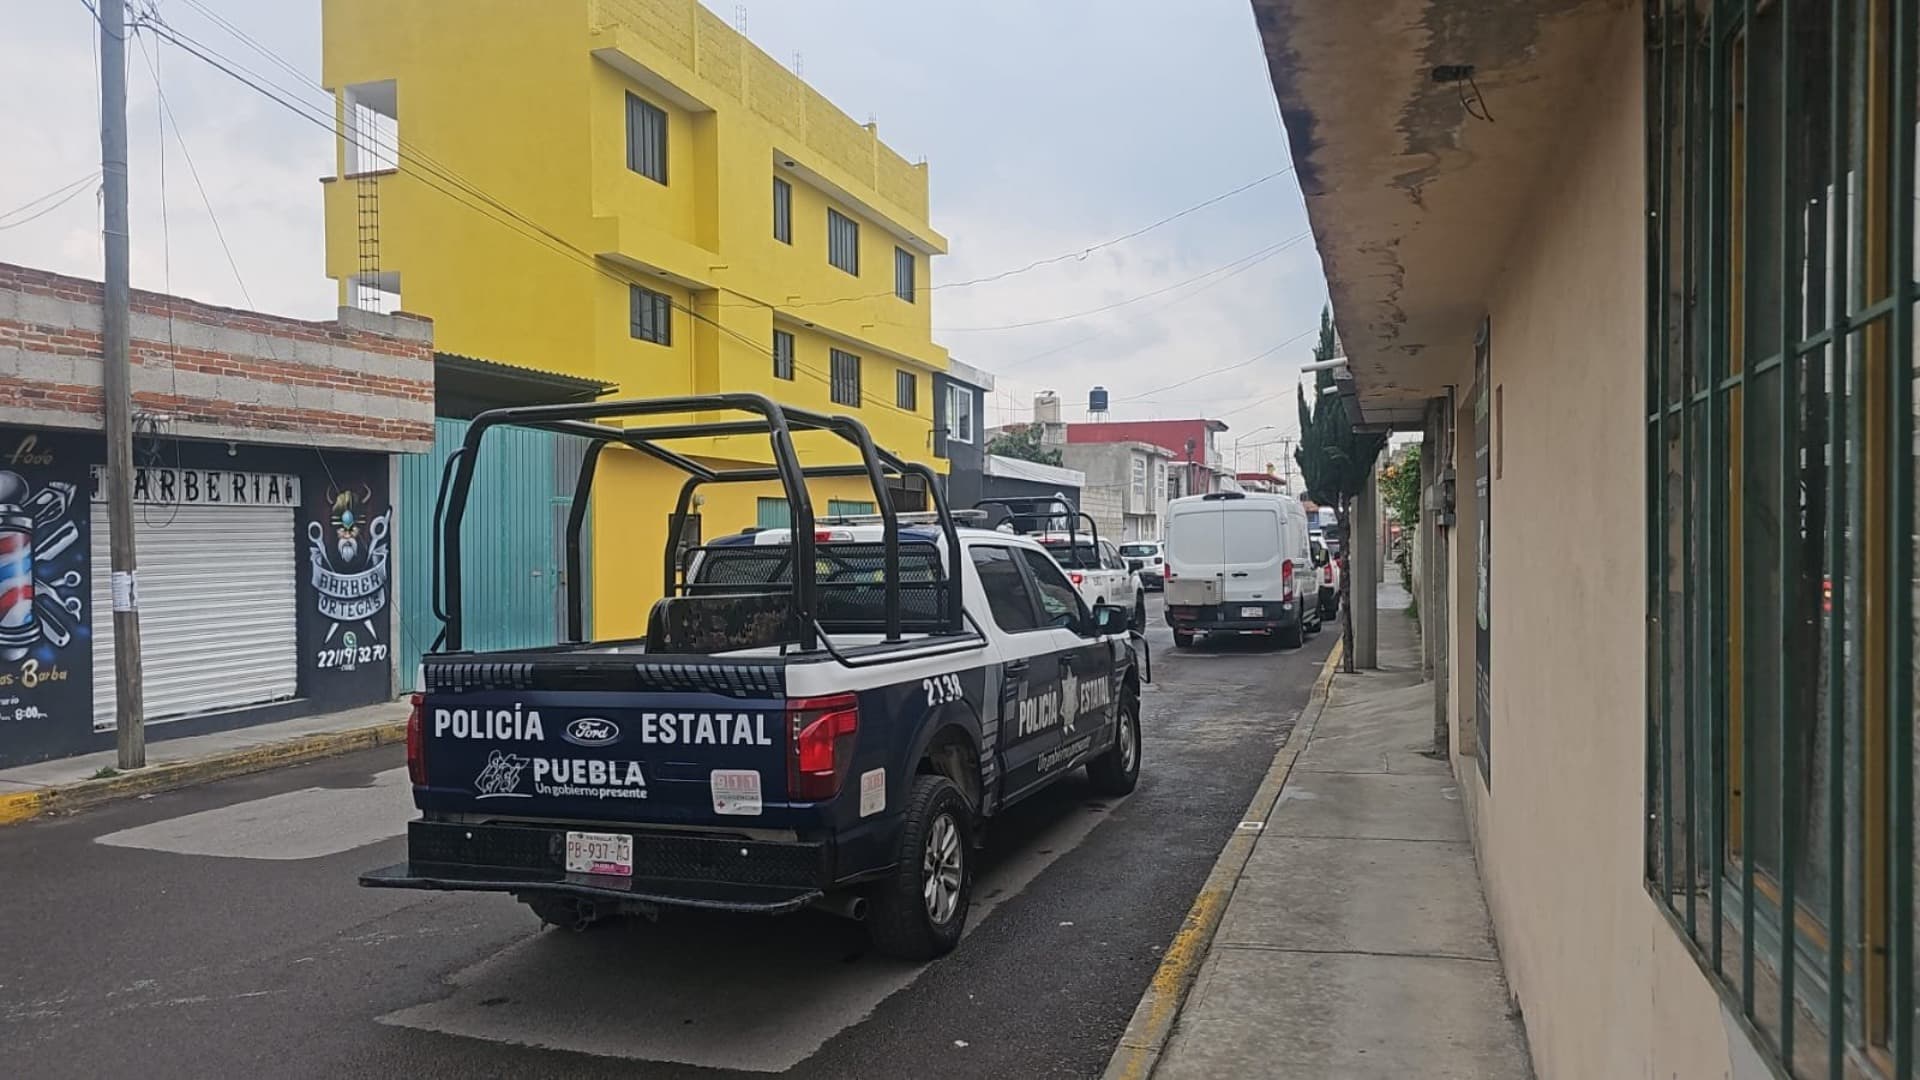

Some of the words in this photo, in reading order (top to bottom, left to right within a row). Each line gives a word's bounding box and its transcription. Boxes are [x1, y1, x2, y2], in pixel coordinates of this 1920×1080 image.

[118, 467, 281, 504] ARBERIA
[320, 573, 380, 596] BARBER
[923, 674, 964, 706] 2138
[1080, 675, 1110, 714] ESTATAL
[434, 702, 545, 742] POLICÍA
[1019, 685, 1057, 737] POLICÍA
[575, 721, 609, 739] Ford
[641, 713, 772, 746] ESTATAL
[533, 757, 646, 787] PUEBLA
[535, 782, 551, 794] Un
[552, 784, 599, 798] gobierno
[599, 787, 648, 800] presente
